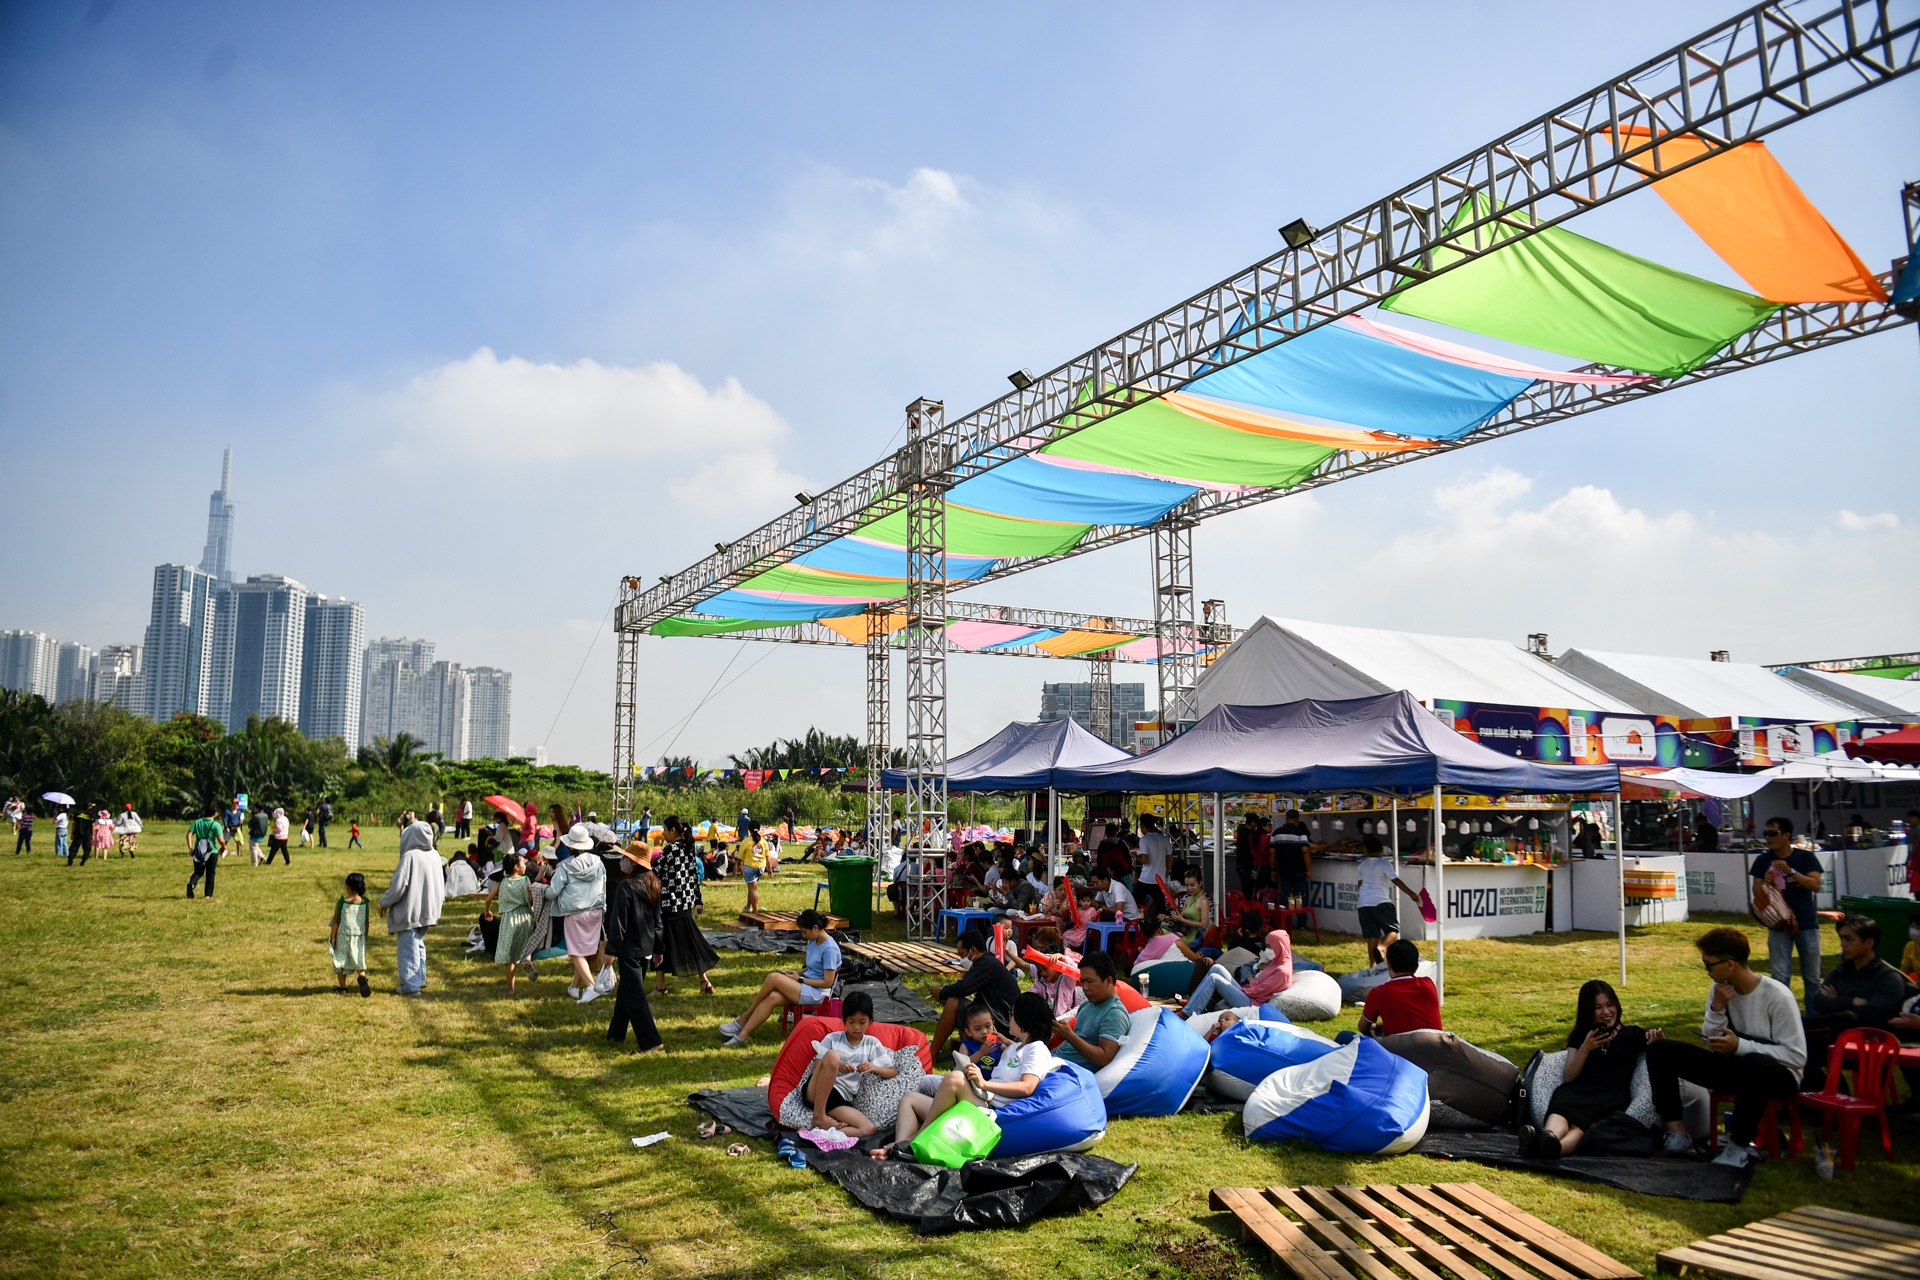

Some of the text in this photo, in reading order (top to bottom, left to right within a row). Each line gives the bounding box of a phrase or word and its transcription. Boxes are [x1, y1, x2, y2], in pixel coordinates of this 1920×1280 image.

[1479, 727, 1493, 737] GIAN
[1703, 871, 1715, 883] 20
[1704, 883, 1716, 895] 22
[1447, 886, 1546, 918] HOZO HO CHI MINH CITY 20
[1499, 896, 1534, 906] INTERNATIONAL
[1535, 900, 1545, 914] 22
[1499, 906, 1534, 916] MUSIC FESTIVAL
